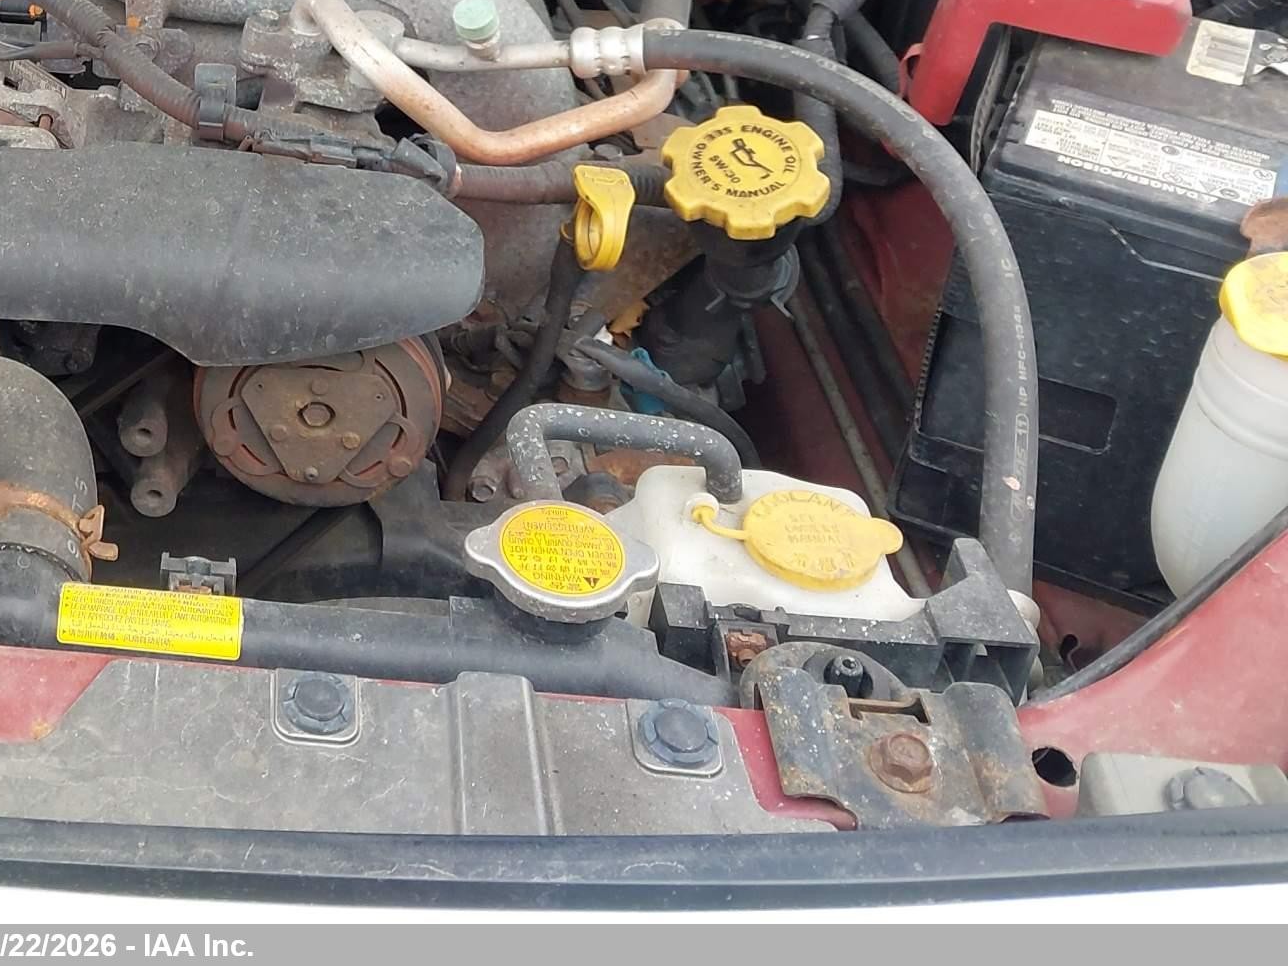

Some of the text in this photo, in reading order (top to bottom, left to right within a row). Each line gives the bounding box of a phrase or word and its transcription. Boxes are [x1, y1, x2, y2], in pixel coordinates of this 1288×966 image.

[692, 142, 721, 193] OWNER'S
[725, 180, 787, 198] MANUAL
[741, 124, 797, 174] ENGINE OIL
[1056, 154, 1205, 200] DANGER/POISON
[529, 546, 559, 555] WHEN
[531, 571, 582, 582] WARNING
